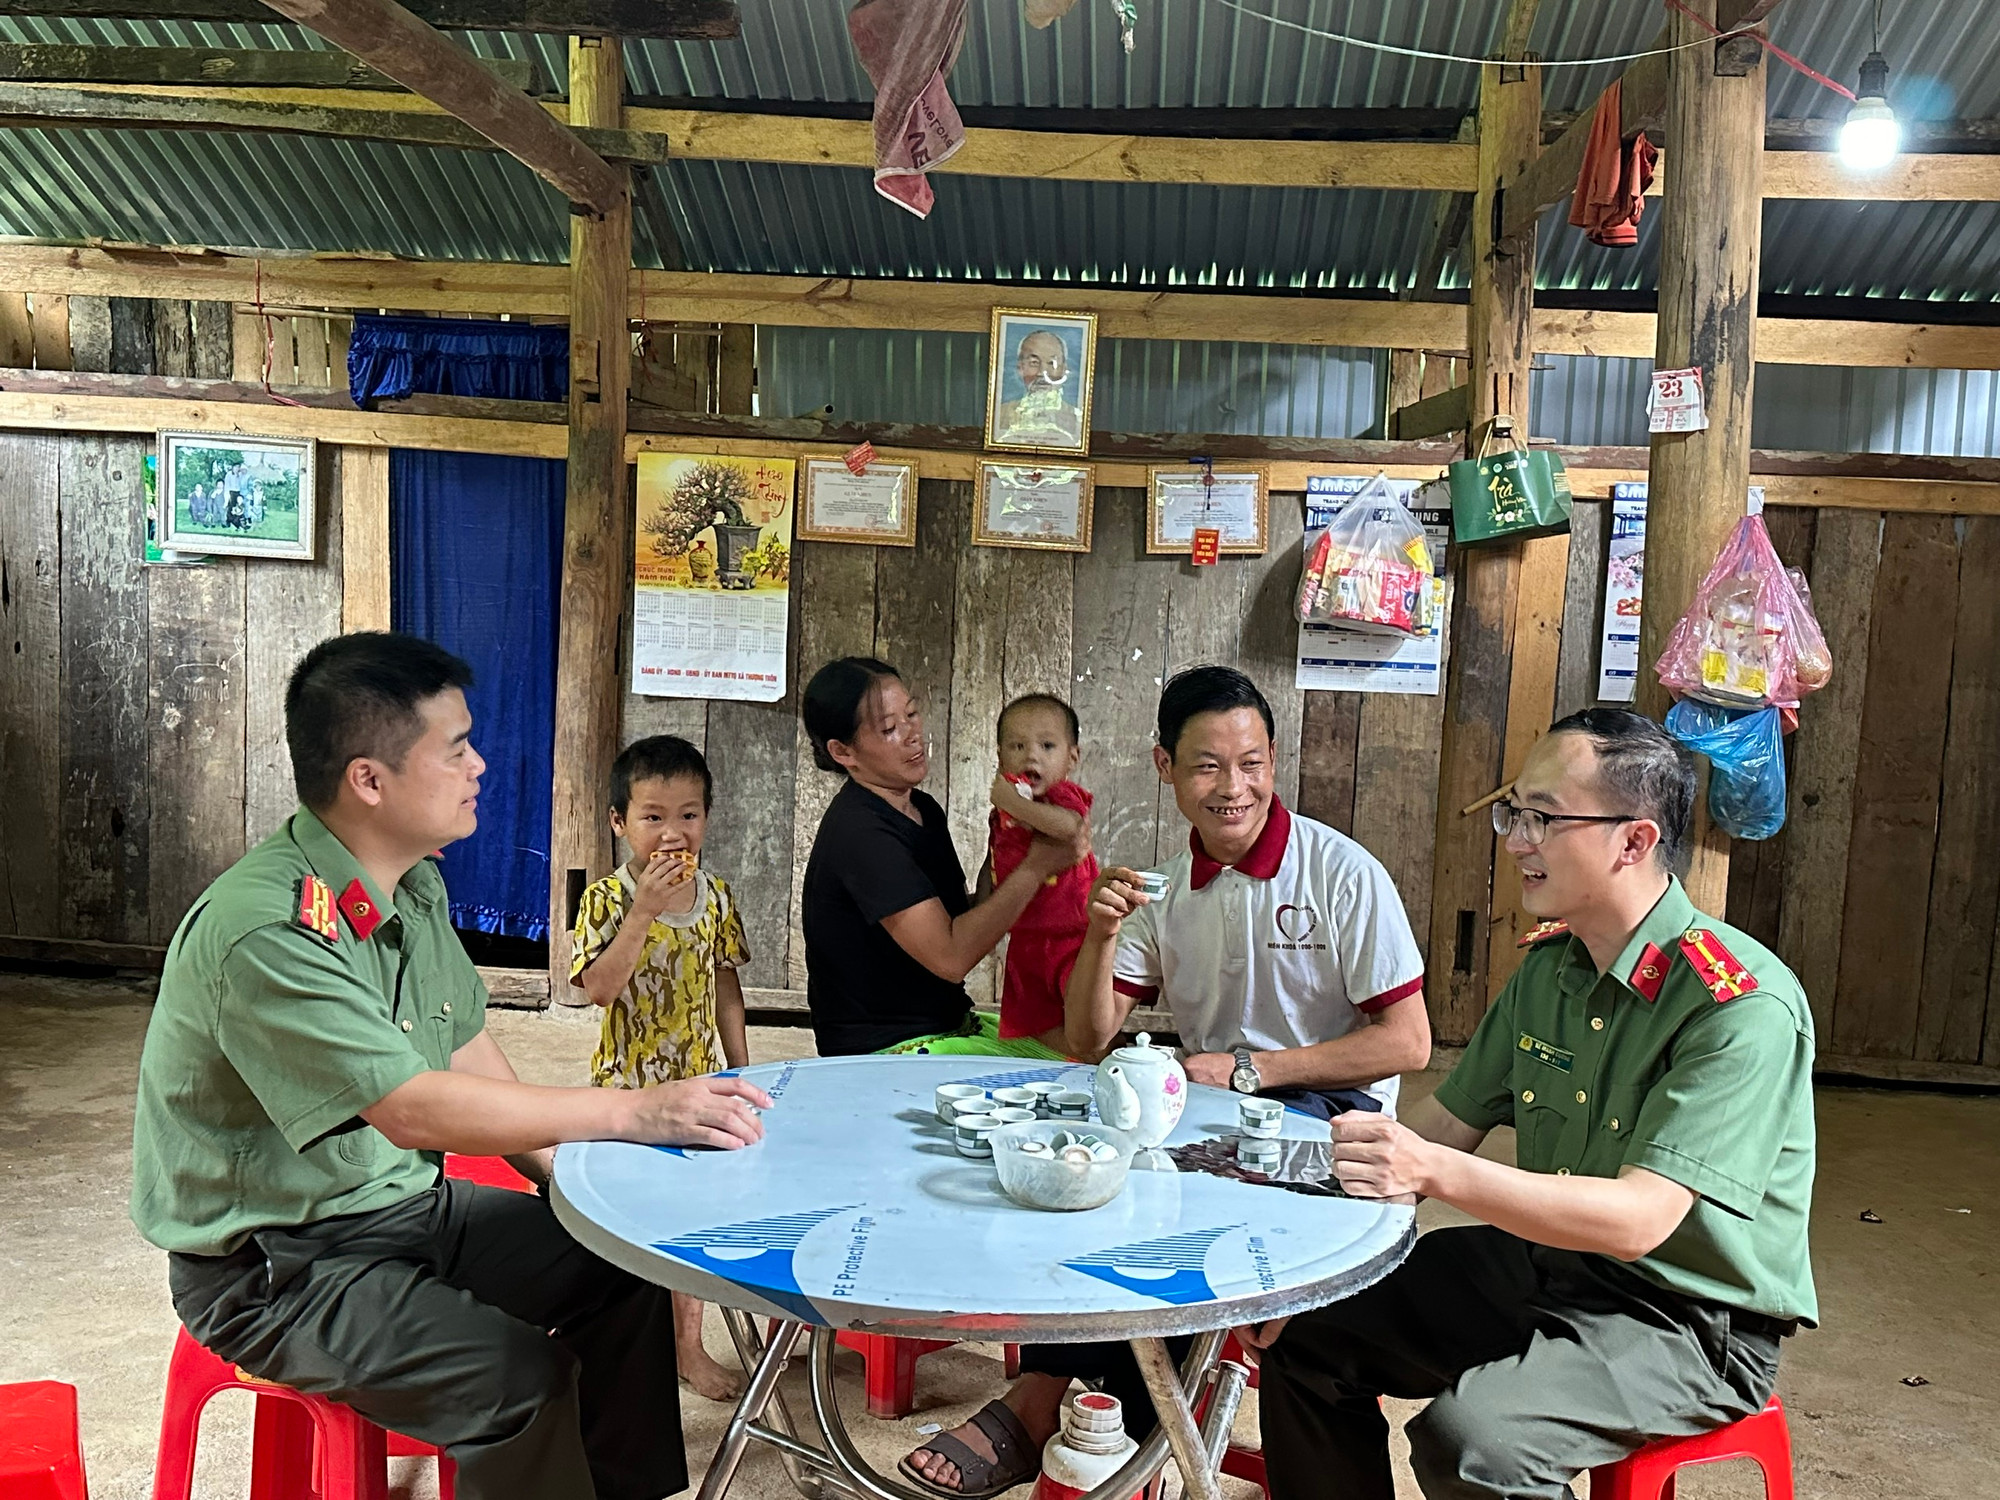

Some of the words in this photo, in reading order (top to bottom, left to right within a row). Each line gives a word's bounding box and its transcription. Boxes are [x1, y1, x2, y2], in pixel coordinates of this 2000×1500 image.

[1658, 380, 1683, 398] 23
[1310, 478, 1366, 494] SAMSU
[1488, 475, 1520, 512] Trà
[851, 1216, 876, 1234] Film
[1246, 1236, 1267, 1254] Film
[837, 1235, 868, 1281] Protective
[832, 1283, 855, 1297] PE
